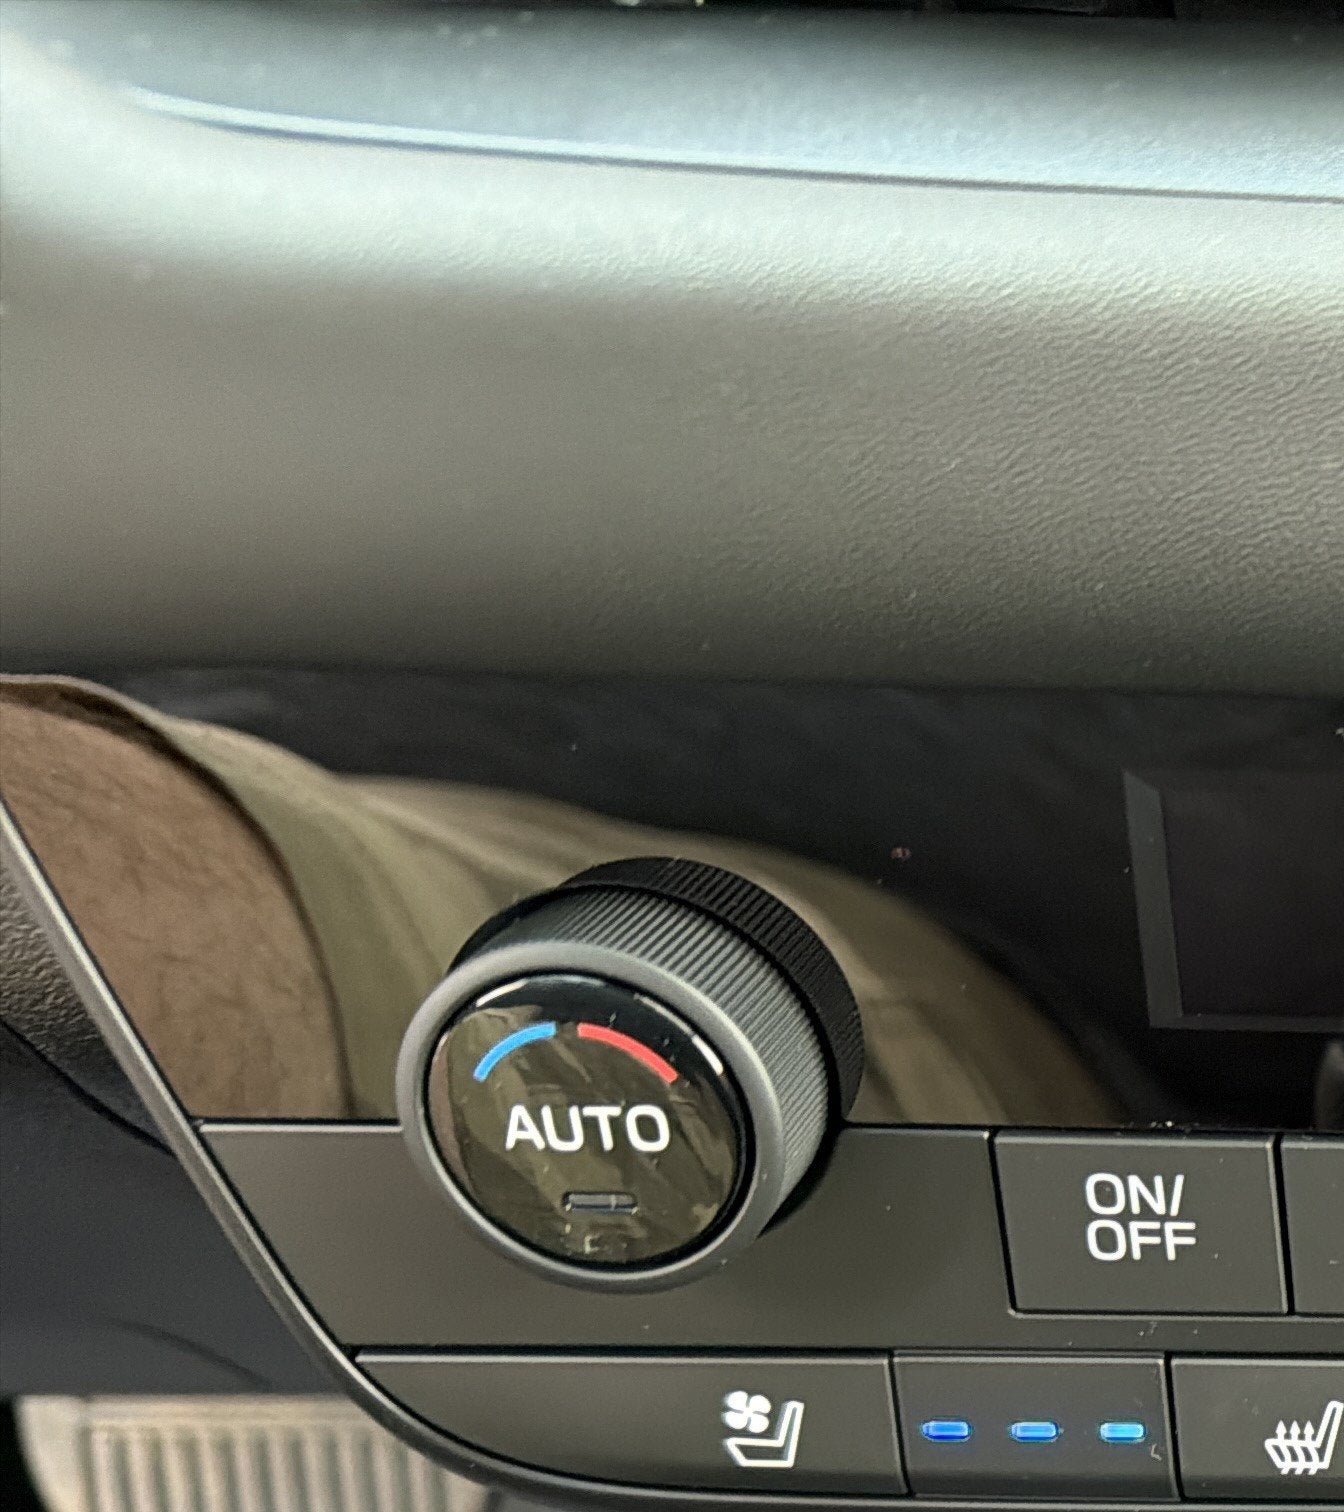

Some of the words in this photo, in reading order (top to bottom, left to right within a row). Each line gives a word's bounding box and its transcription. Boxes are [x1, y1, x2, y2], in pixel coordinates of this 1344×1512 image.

[505, 1102, 670, 1154] AUTO
[1085, 1172, 1185, 1217] ON/
[1086, 1219, 1197, 1262] OFF
